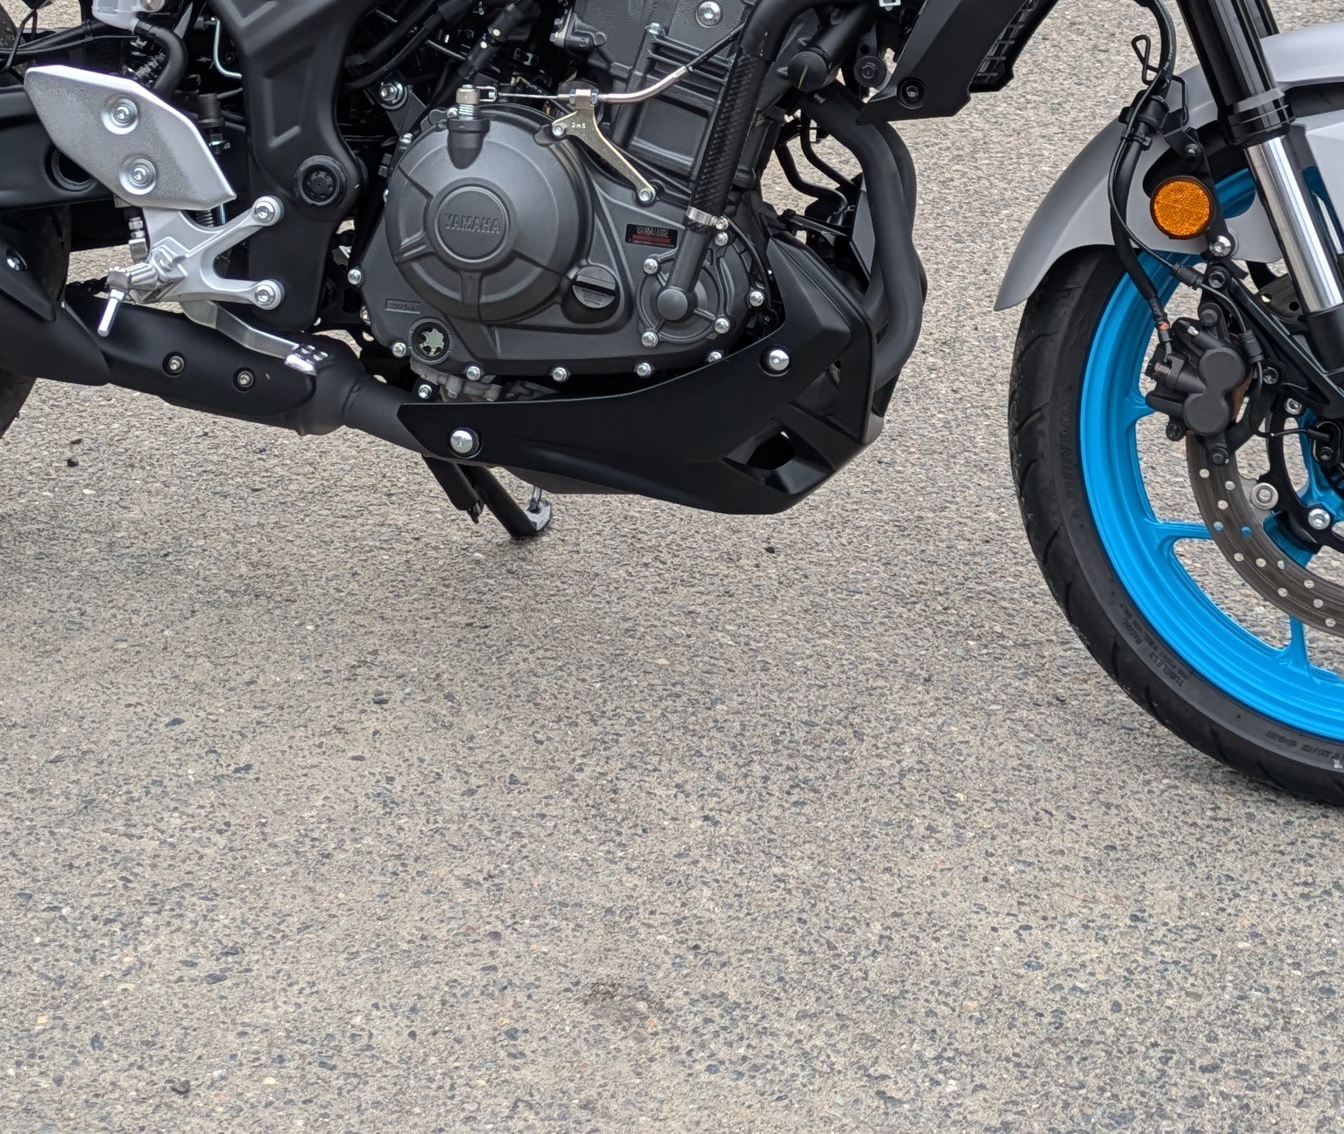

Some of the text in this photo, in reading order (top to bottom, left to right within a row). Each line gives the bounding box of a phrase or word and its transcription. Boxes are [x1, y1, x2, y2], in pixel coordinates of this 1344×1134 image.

[444, 212, 500, 234] YAMAHA
[1121, 617, 1185, 687] TUBELESS RADIAL
